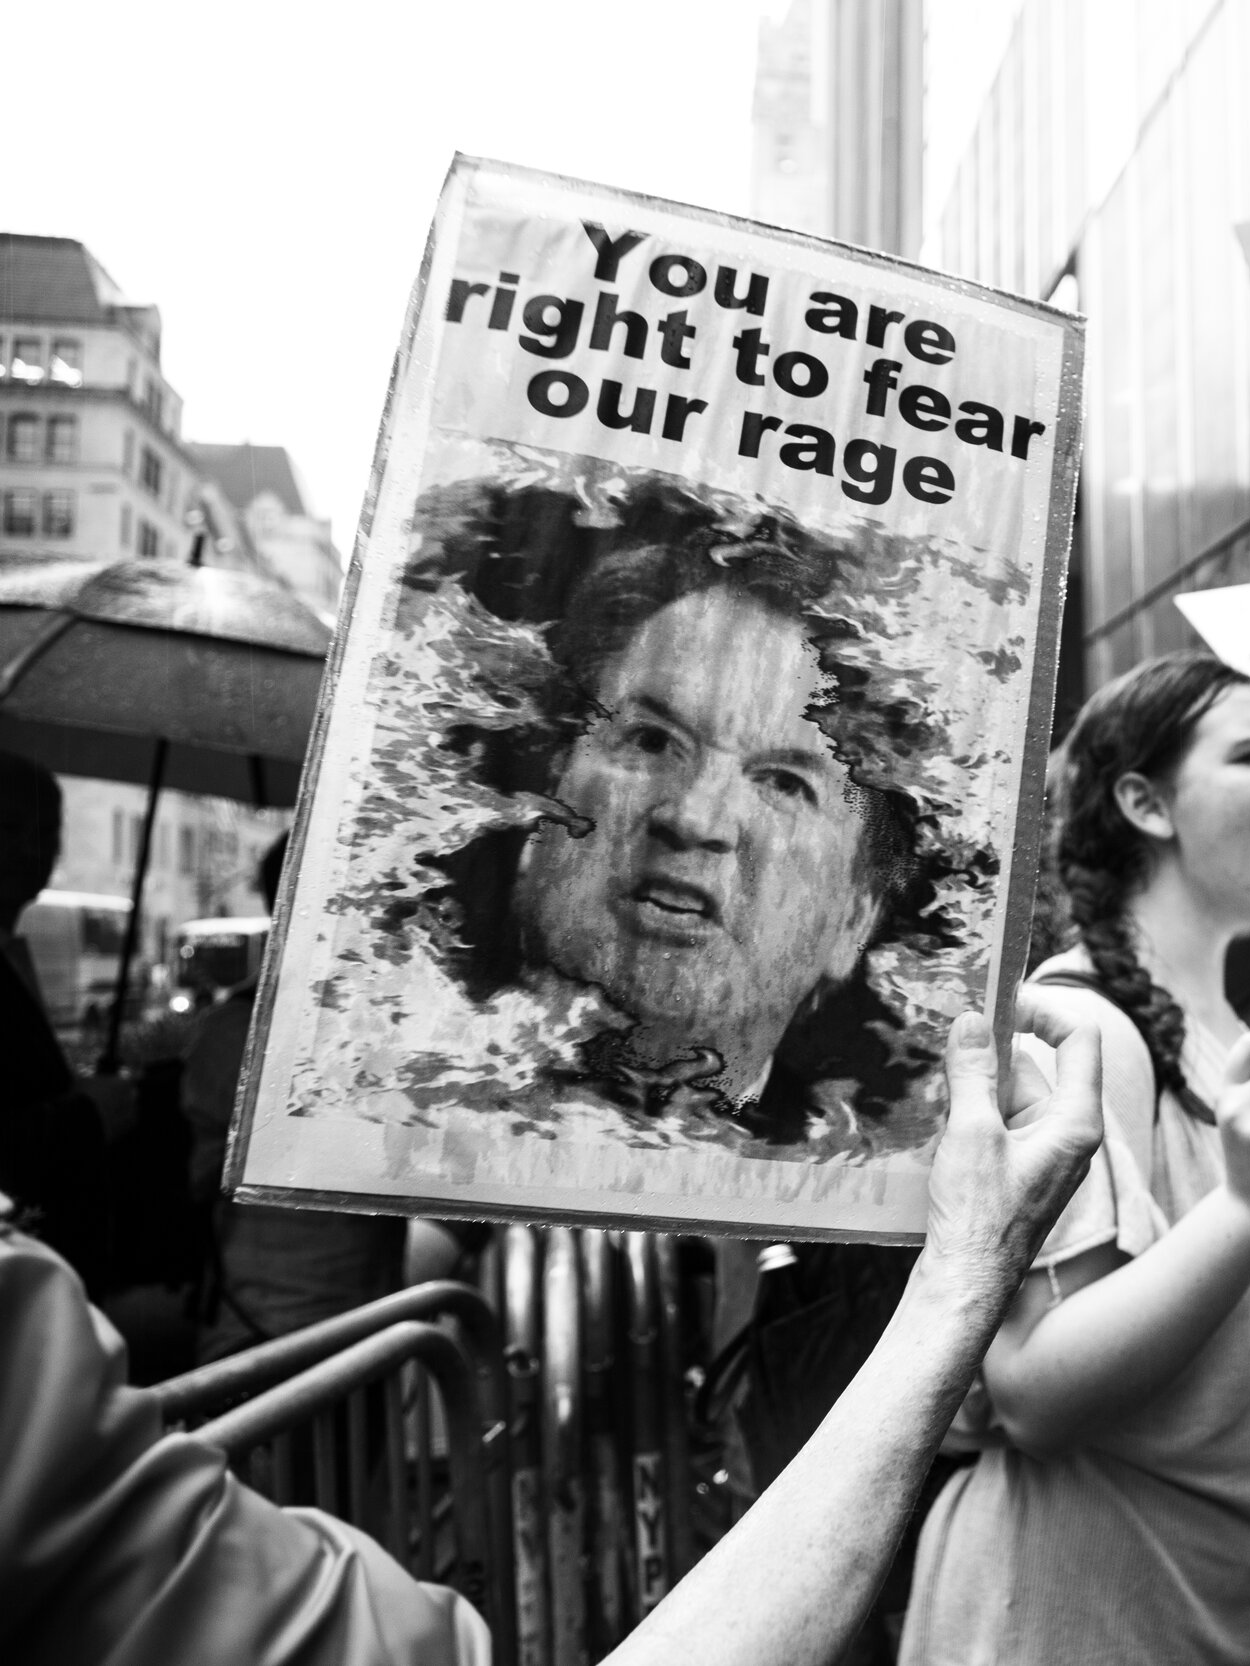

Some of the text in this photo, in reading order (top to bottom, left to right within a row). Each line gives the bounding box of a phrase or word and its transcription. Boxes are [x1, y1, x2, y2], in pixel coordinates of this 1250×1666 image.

[580, 217, 957, 365] You are
[445, 271, 1046, 460] right to fear
[526, 370, 956, 505] our rage
